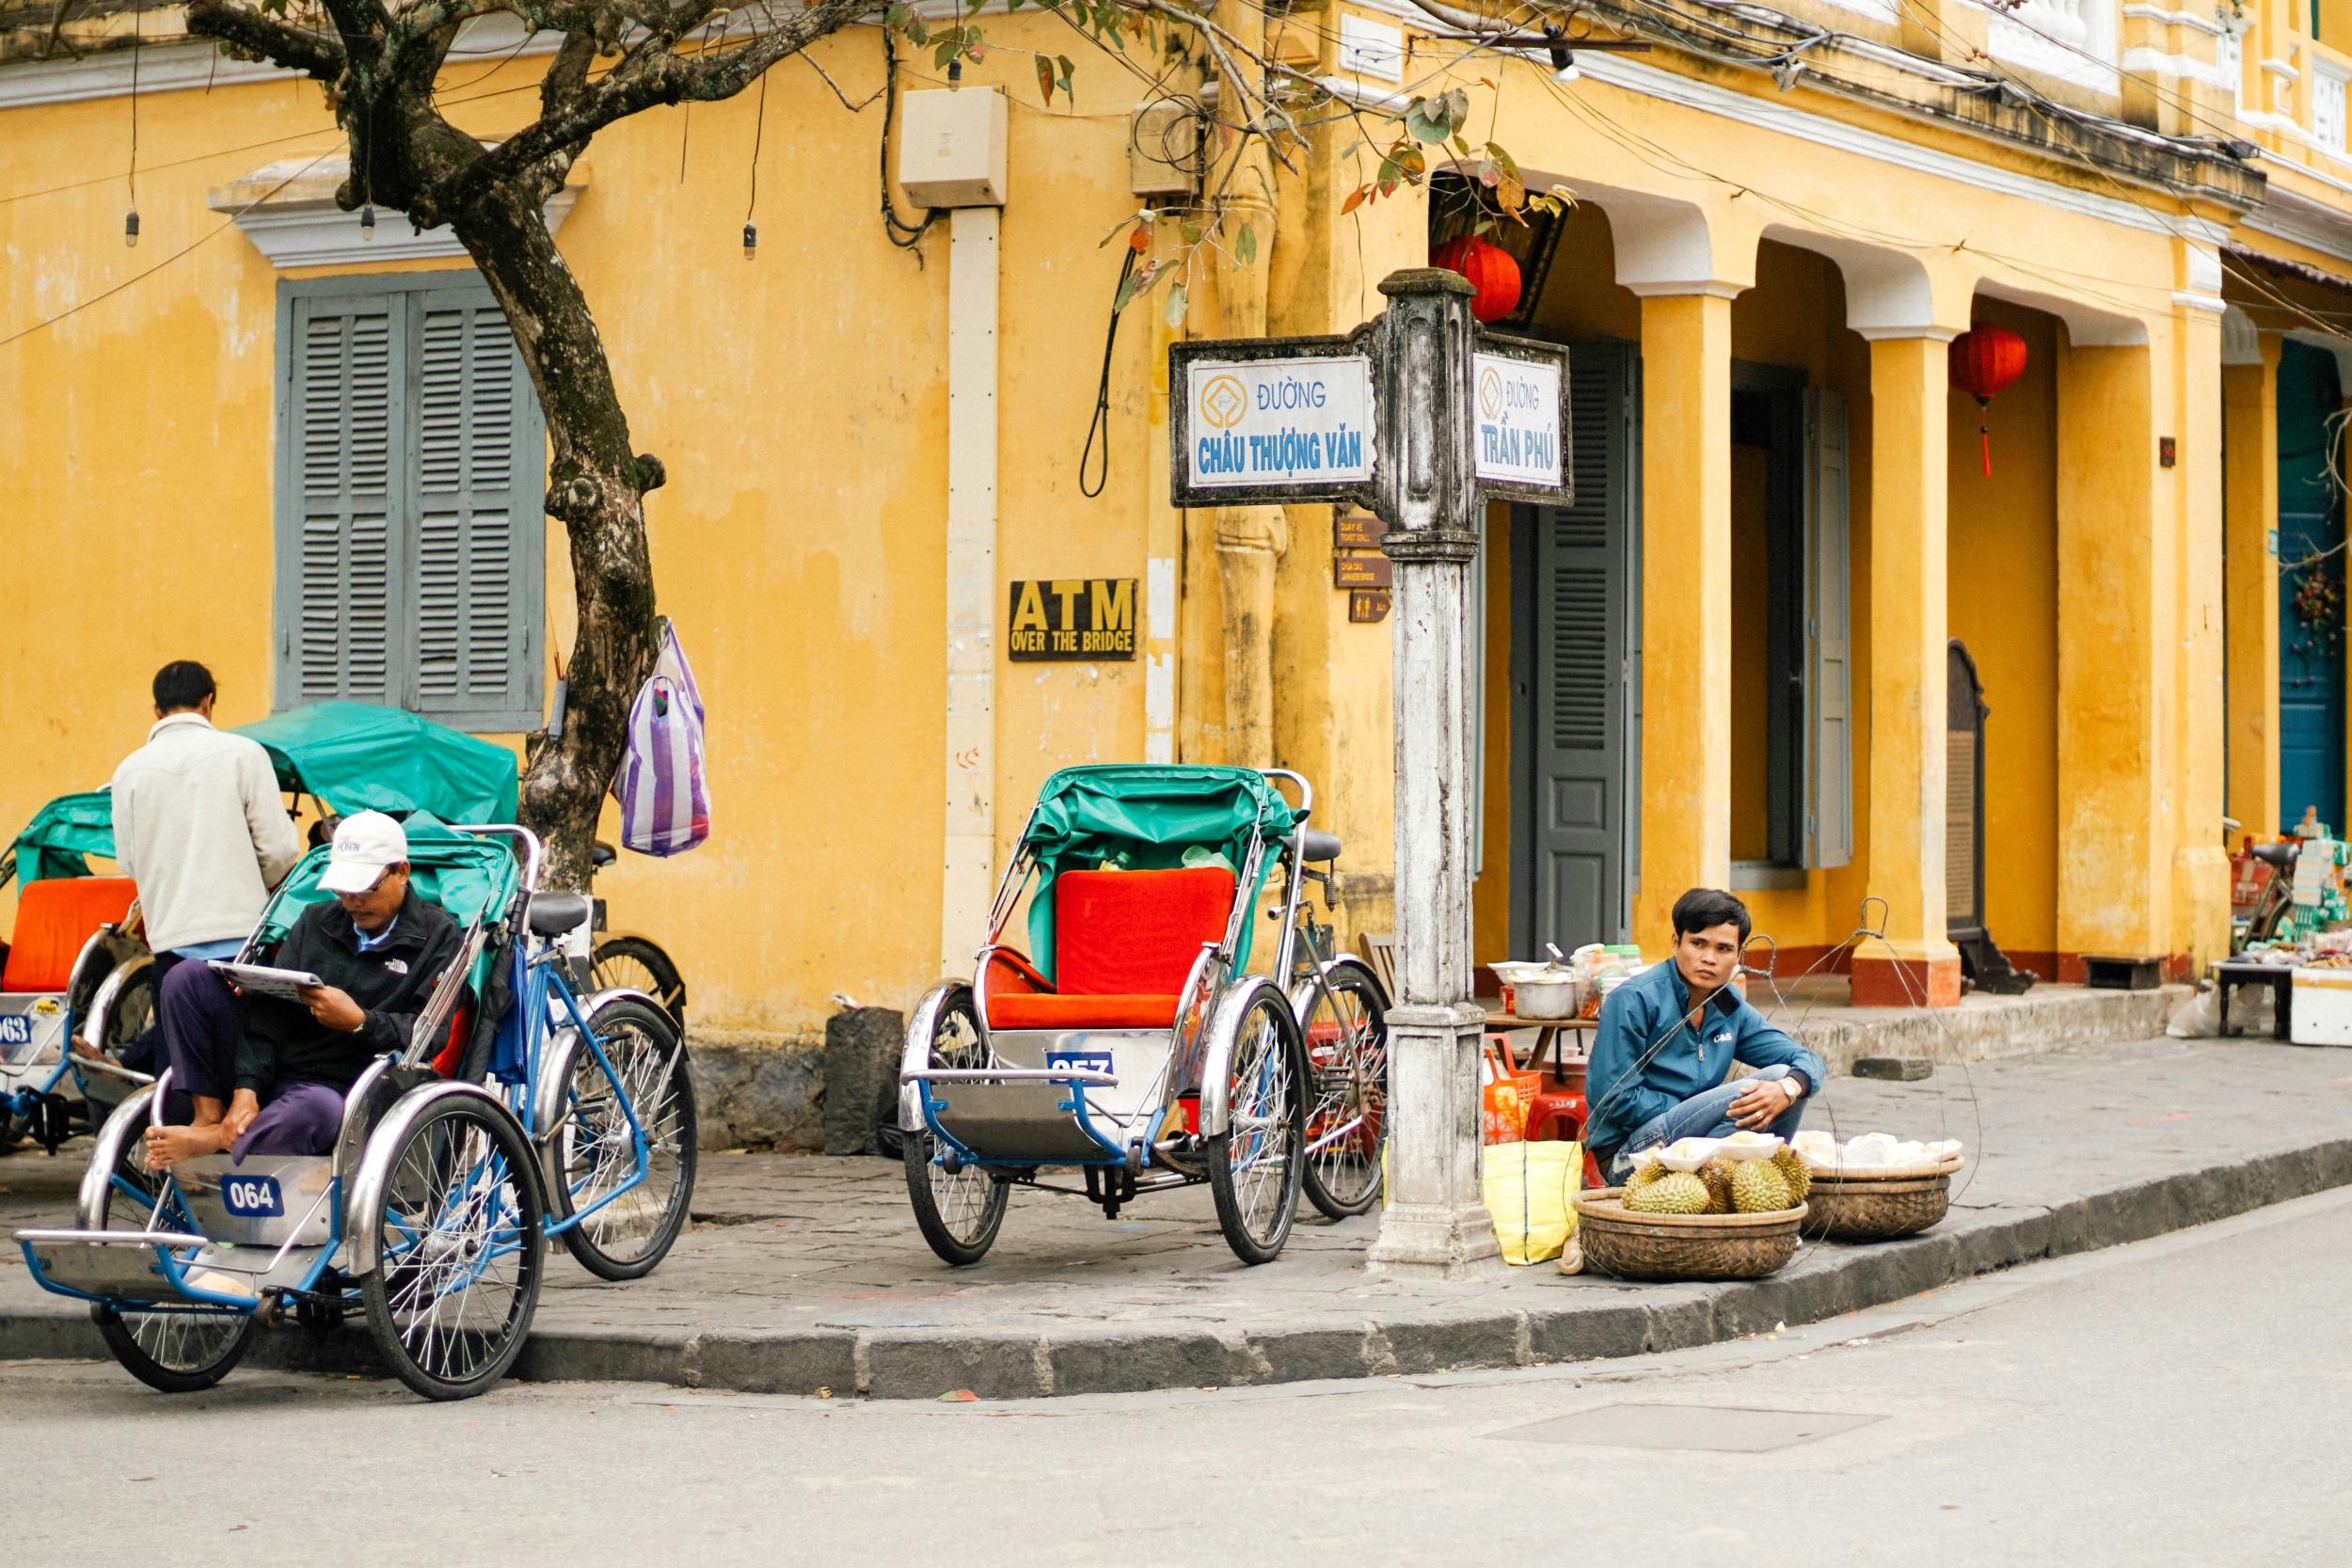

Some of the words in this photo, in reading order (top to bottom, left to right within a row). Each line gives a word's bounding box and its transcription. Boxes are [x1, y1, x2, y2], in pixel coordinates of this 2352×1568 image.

[1257, 375, 1326, 410] ĐƯỜNG
[1506, 375, 1539, 410] ĐƯỜNG
[1198, 429, 1246, 474] CHÂU
[1249, 426, 1321, 477] THƯỢNG
[1325, 422, 1361, 468] VĂN
[1481, 410, 1520, 467] TRẦN
[1525, 422, 1554, 470] PHÚ
[1011, 579, 1133, 630] ATM
[1010, 631, 1046, 651] OVER
[1052, 631, 1078, 651] THE
[1083, 630, 1133, 652] BRIDGE
[0, 1016, 28, 1042] 63
[1713, 1032, 1732, 1043] C&S
[230, 1182, 274, 1209] 064
